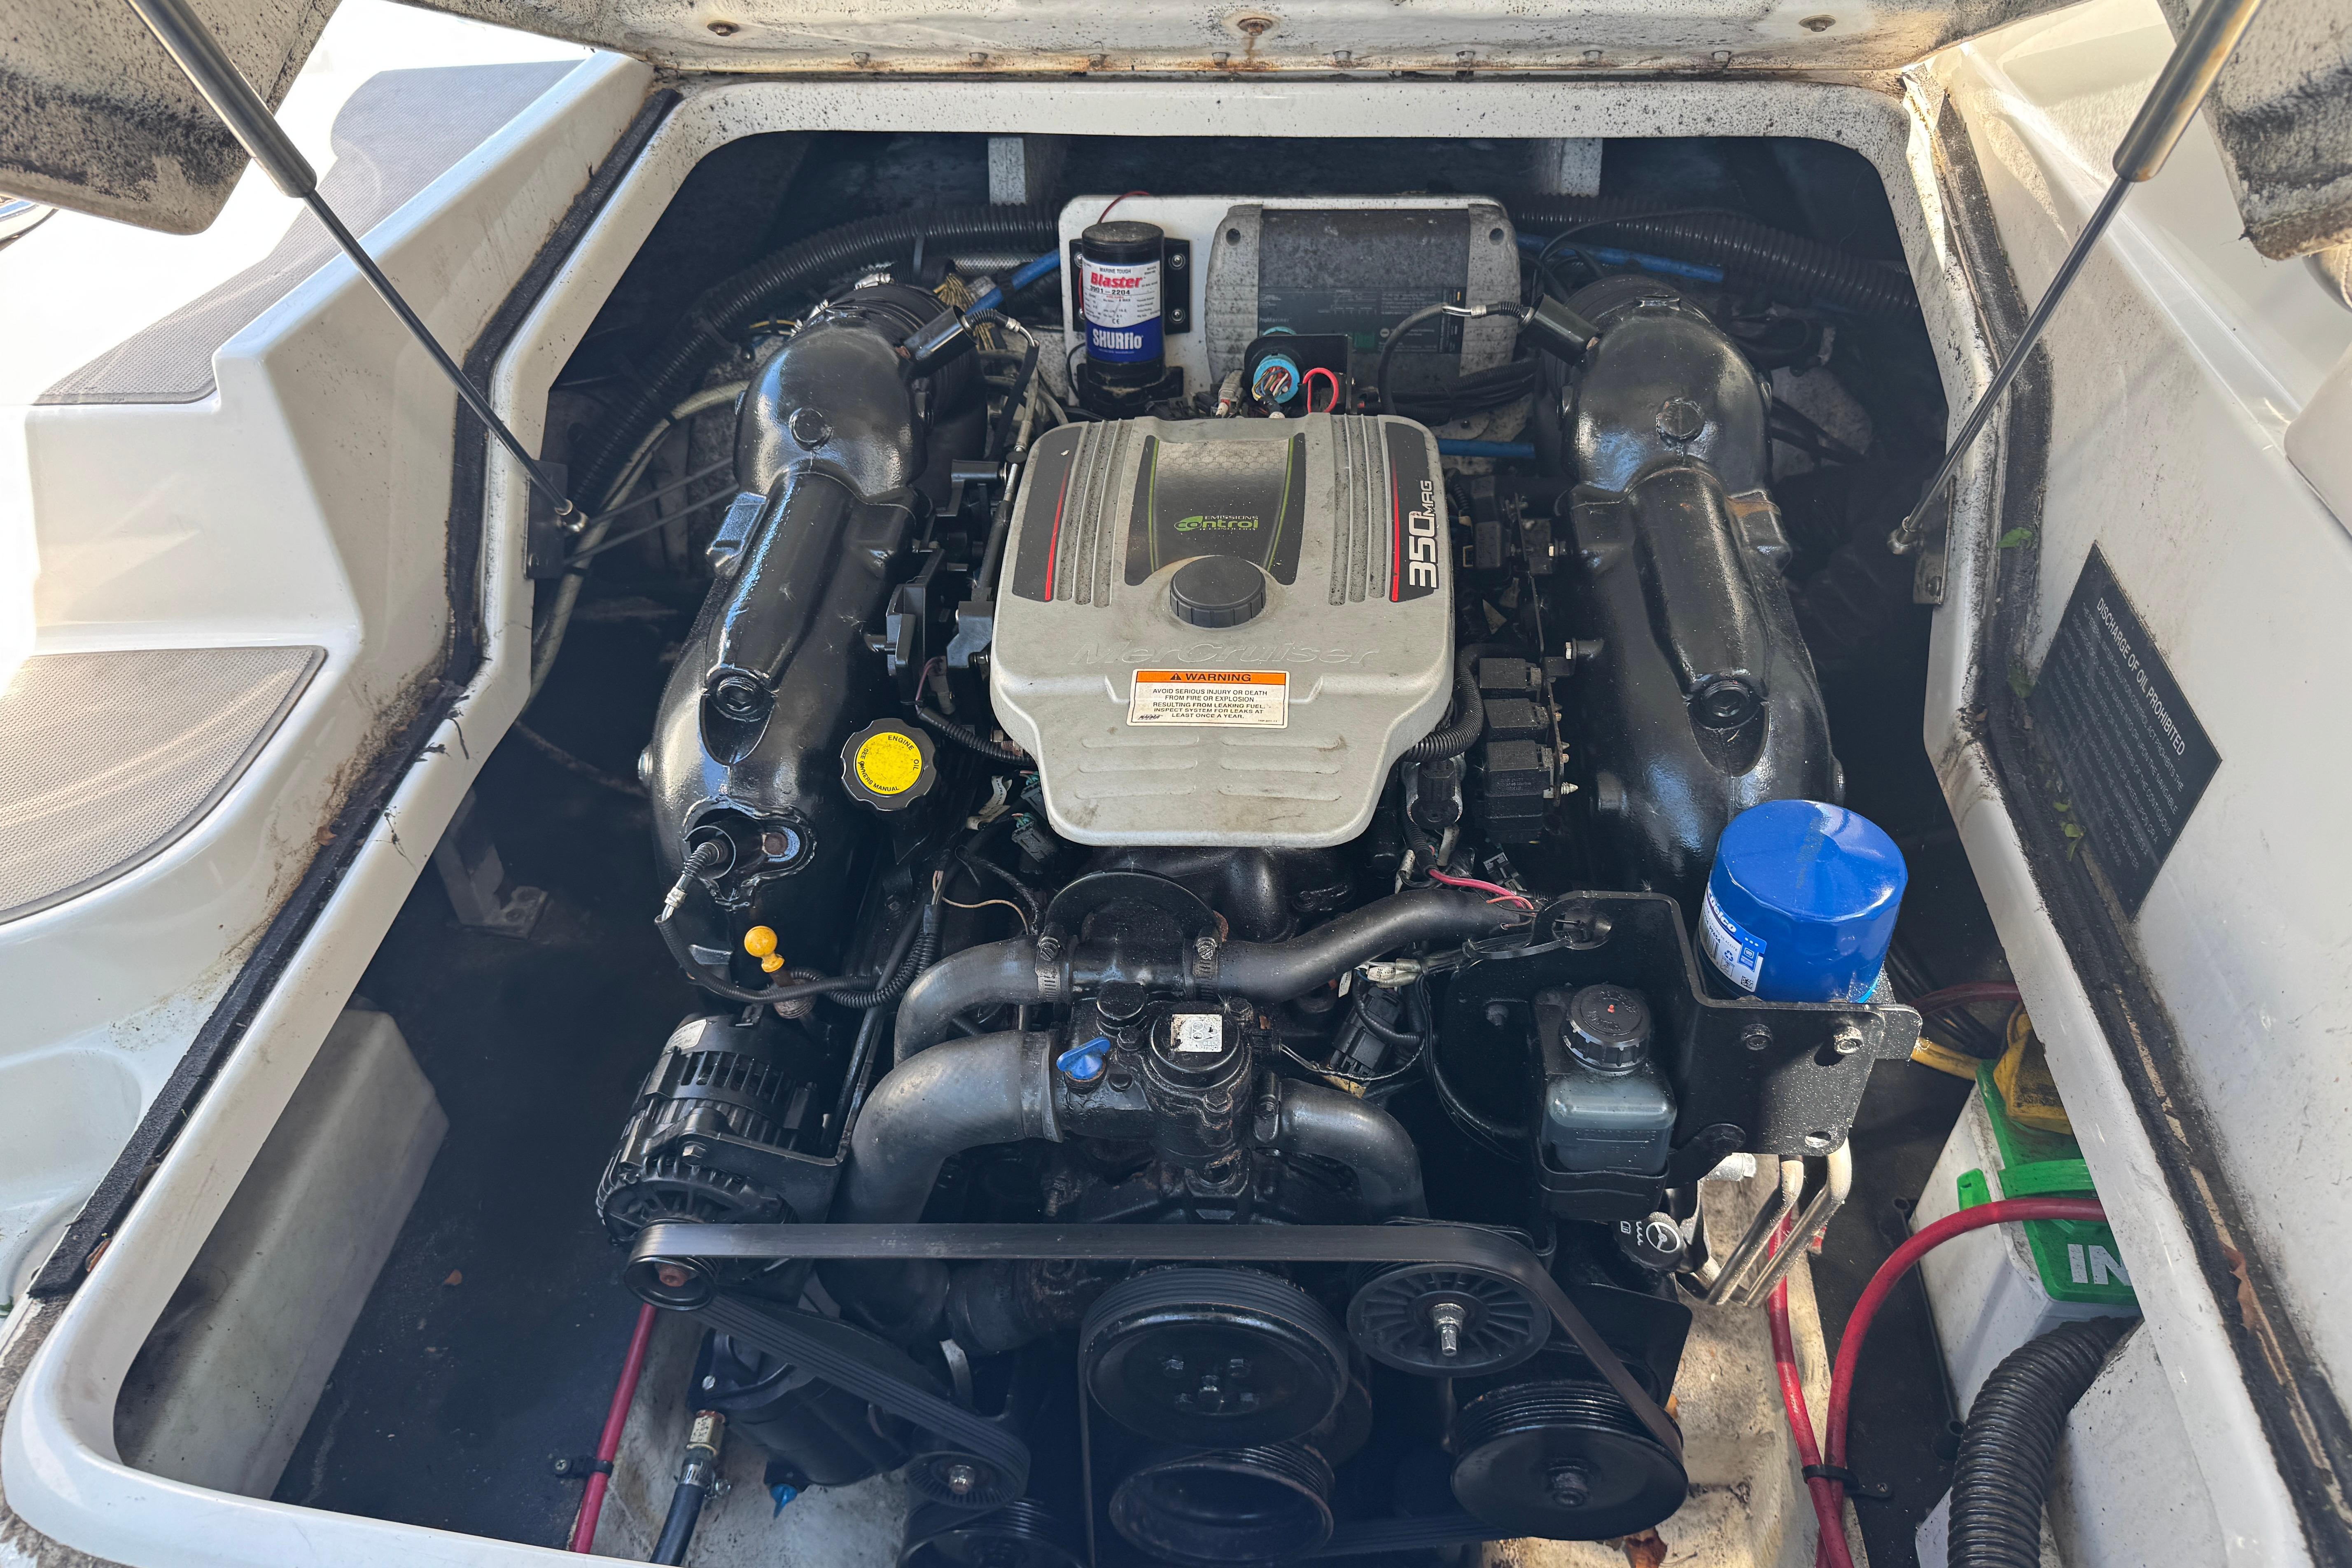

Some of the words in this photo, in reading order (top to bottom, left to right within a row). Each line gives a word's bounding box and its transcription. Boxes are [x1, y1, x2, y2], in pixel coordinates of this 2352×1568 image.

[1091, 272, 1143, 288] Blaster
[1421, 481, 1435, 517] MAG
[1409, 511, 1437, 588] 350
[1068, 641, 1379, 664] MerCruiser
[1185, 673, 1251, 681] WARNING
[2095, 595, 2131, 660] DISCHARGE
[2126, 651, 2140, 676] OF
[2135, 666, 2150, 694] OIL
[2145, 684, 2186, 758] PROHIBITED
[888, 735, 914, 751] ENGINE
[2111, 658, 2133, 699] POLLUTION
[2129, 692, 2150, 729] CONTROL
[2146, 723, 2157, 743] ACT
[2153, 736, 2176, 779] PROHIBITS
[2172, 772, 2184, 793] THE
[860, 748, 869, 760] SEE
[2110, 688, 2126, 717] WASTE
[2130, 726, 2140, 743] OR
[2136, 738, 2150, 763] UPON
[2147, 757, 2158, 777] THE
[2154, 772, 2179, 816] NAVIGABLE
[858, 761, 873, 785] OWNERS
[873, 783, 900, 792] MANUAL
[2124, 778, 2140, 807] SHEEN
[2146, 821, 2156, 839] OR
[2152, 833, 2159, 846] A
[2132, 762, 2141, 779] OF
[2138, 772, 2148, 793] THE
[2144, 786, 2172, 838] CONTIGUOUS
[2128, 817, 2146, 852] CAUSES
